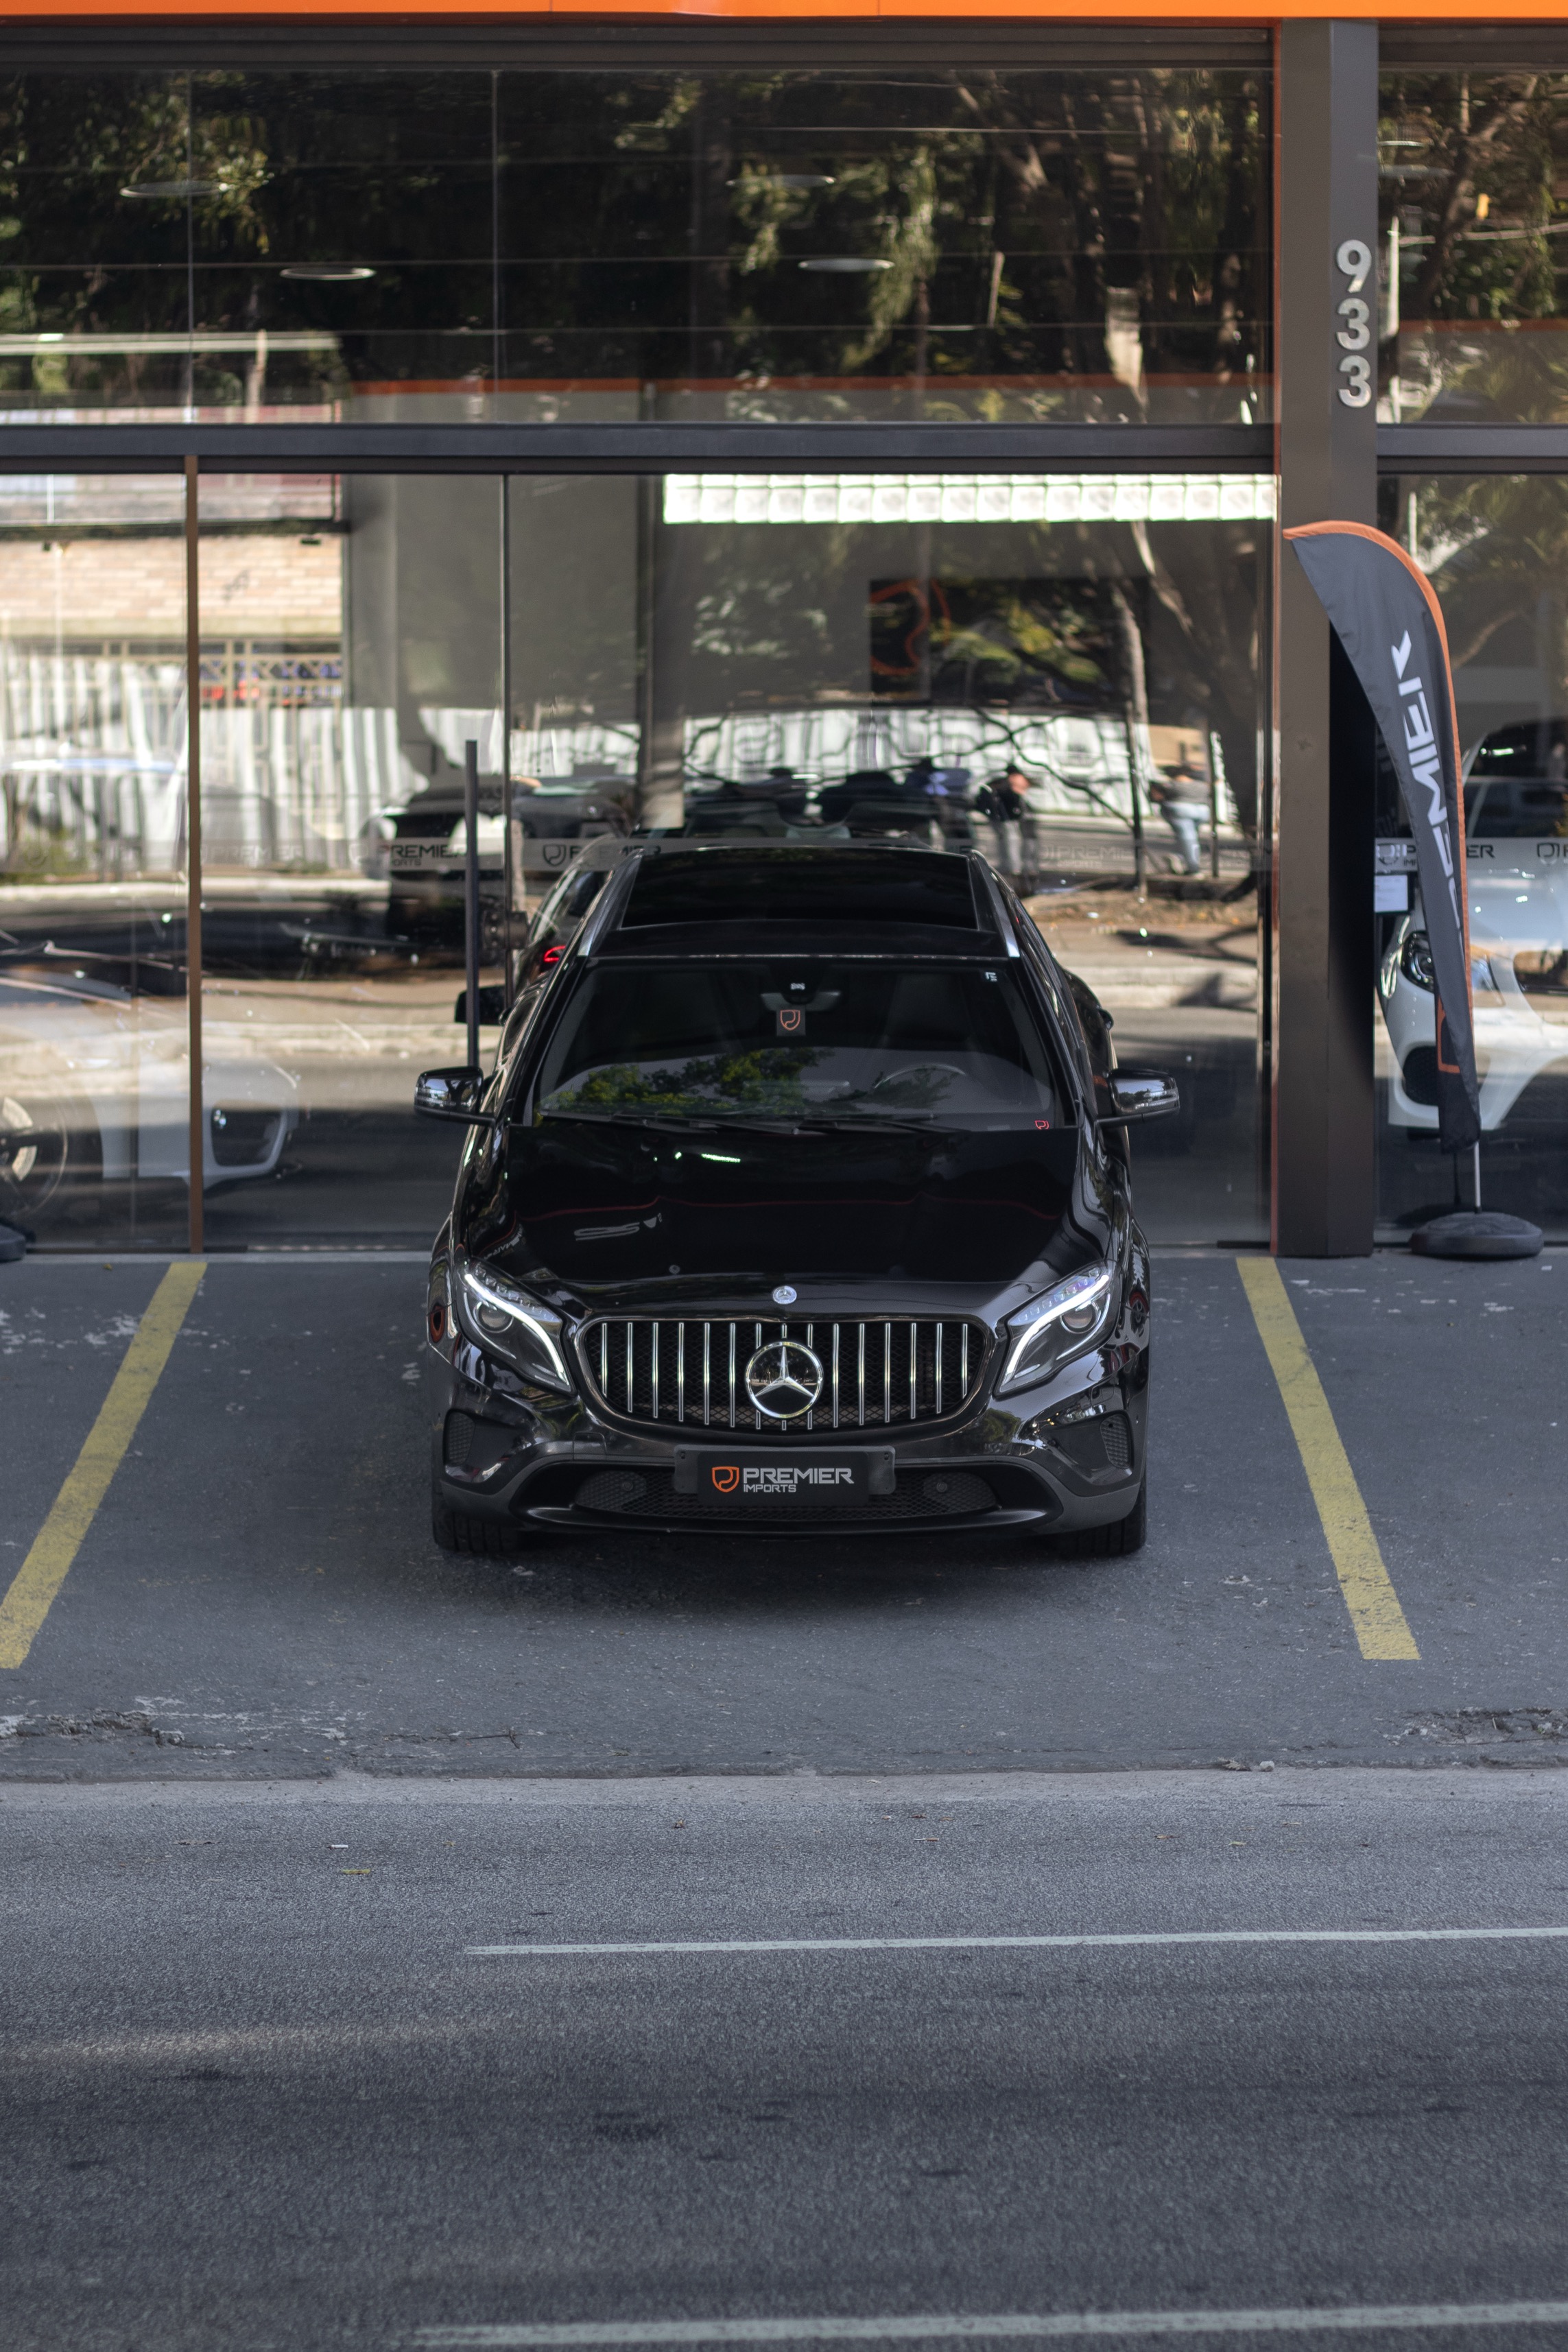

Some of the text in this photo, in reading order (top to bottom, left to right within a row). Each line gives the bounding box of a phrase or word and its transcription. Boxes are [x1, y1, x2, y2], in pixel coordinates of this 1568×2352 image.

[1336, 239, 1372, 408] 933
[743, 1468, 855, 1484] PREMIER
[743, 1484, 796, 1493] IMPORTS
